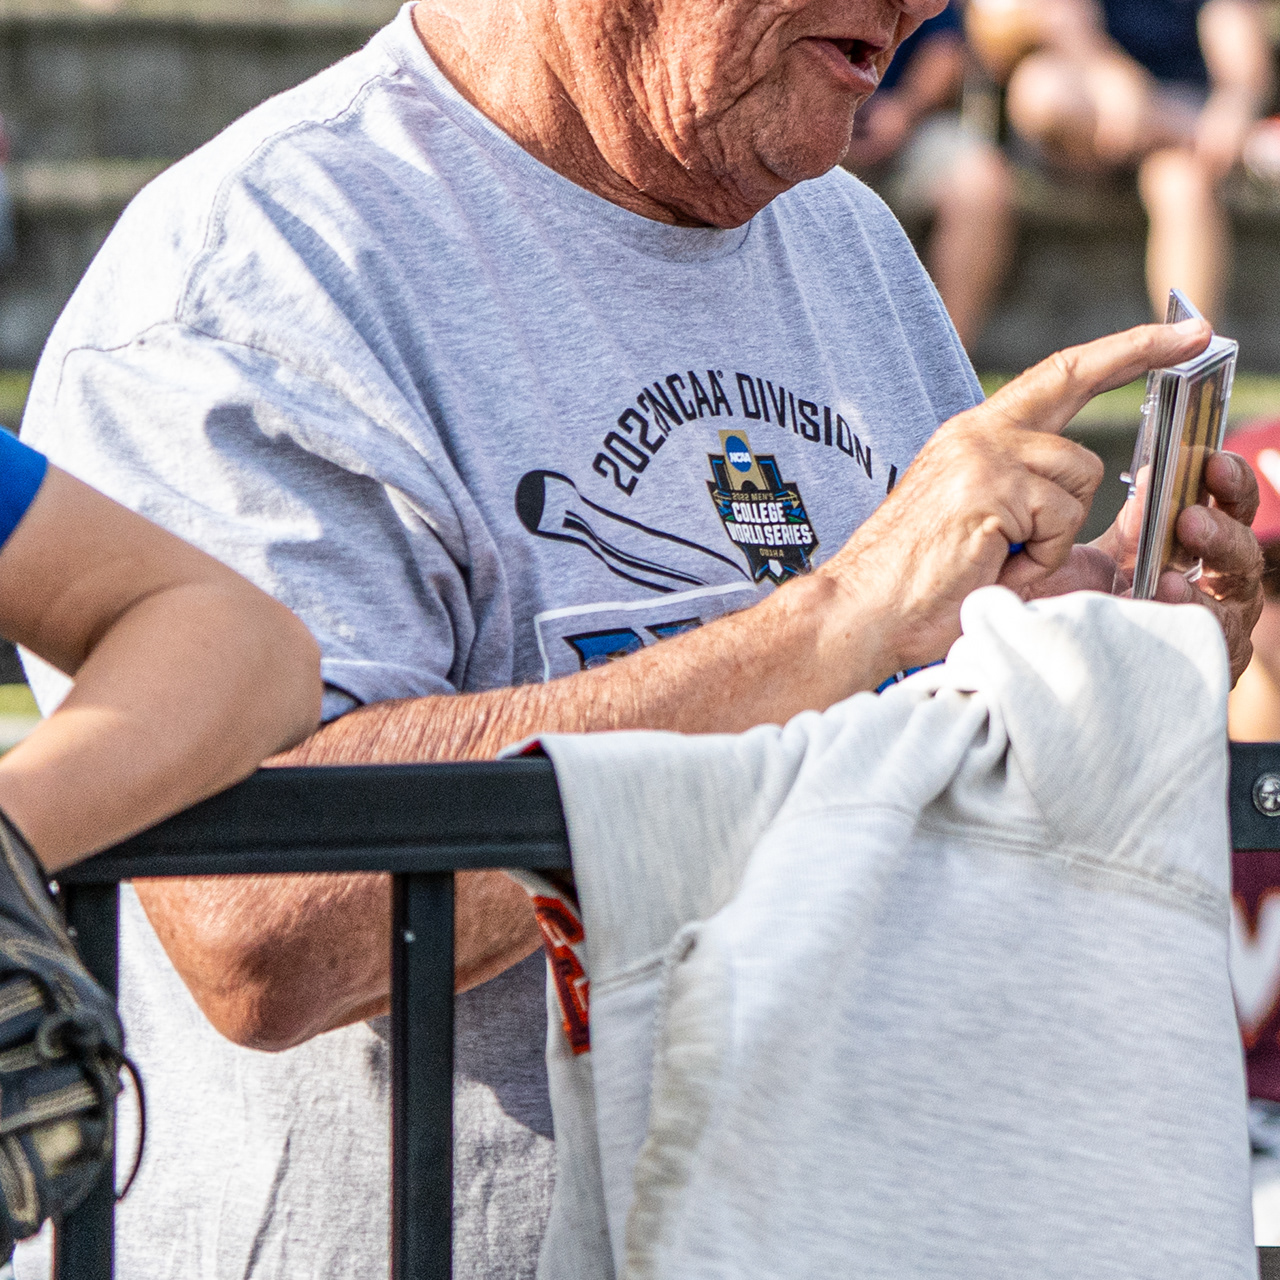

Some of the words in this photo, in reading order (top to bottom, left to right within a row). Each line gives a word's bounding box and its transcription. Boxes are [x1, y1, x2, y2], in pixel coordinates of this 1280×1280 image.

[735, 372, 872, 480] DIVISION
[731, 502, 786, 524] COLLEGE
[725, 521, 765, 545] WORLD
[763, 524, 813, 546] SERIES
